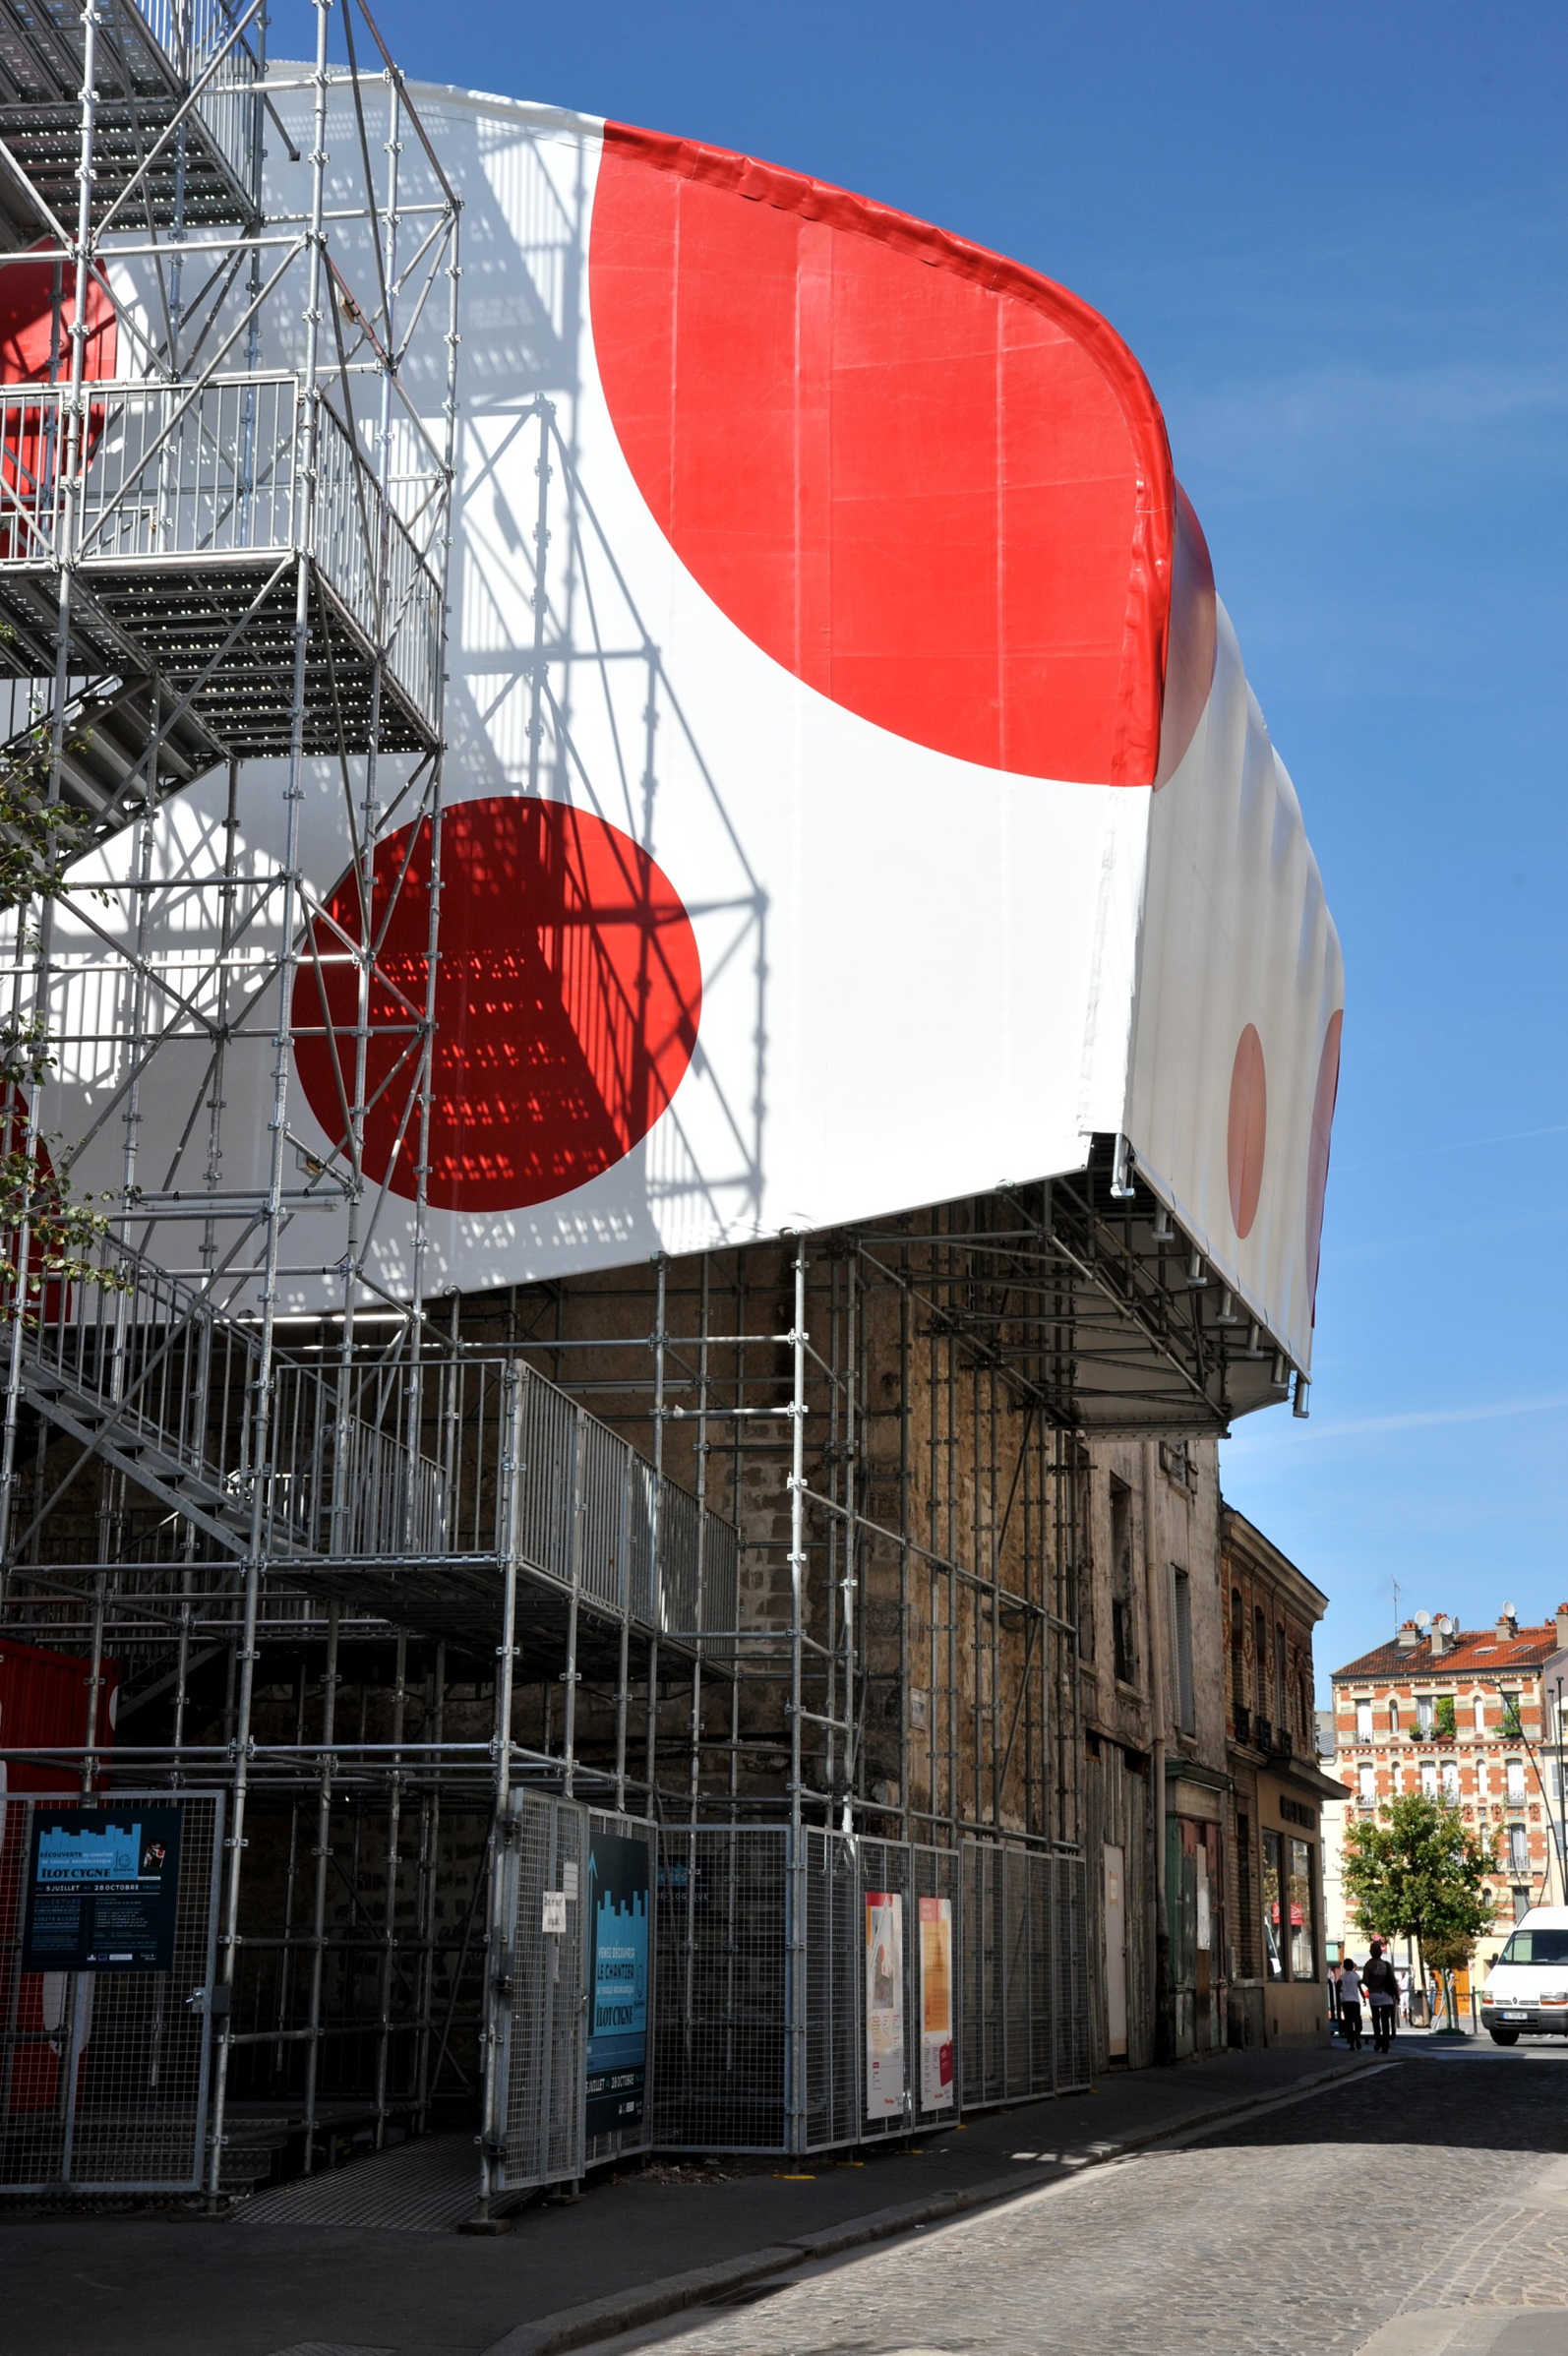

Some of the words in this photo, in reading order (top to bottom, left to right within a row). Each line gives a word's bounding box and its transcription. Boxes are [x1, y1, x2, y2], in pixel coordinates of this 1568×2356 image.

[41, 1867, 70, 1878] ÎLOT
[71, 1868, 111, 1878] CYGNE
[597, 1963, 604, 1980] LE
[605, 1963, 634, 1980] CHANTIER
[596, 2003, 613, 2027] ÎLOT
[613, 2006, 633, 2025] CYGNE
